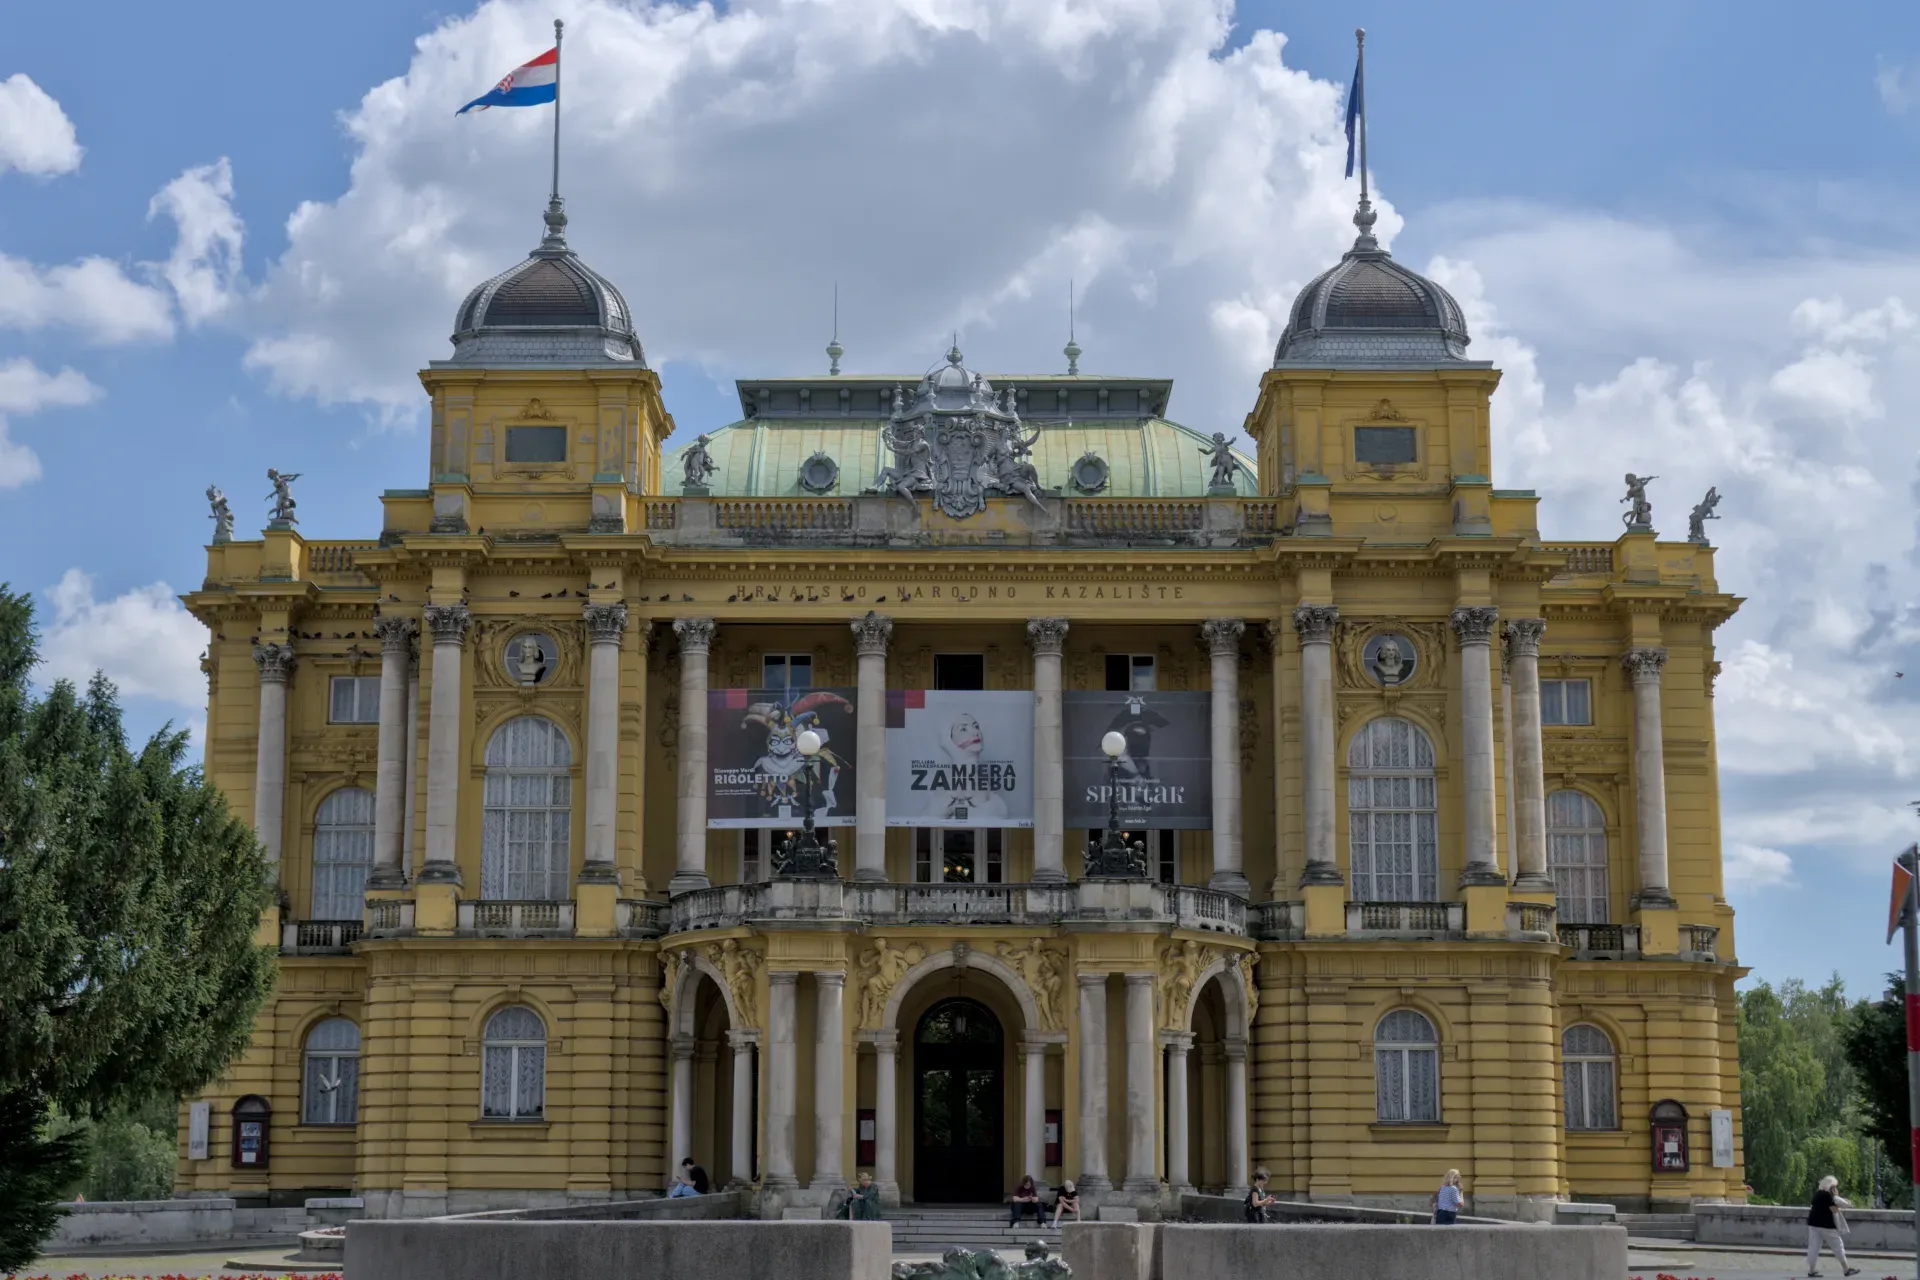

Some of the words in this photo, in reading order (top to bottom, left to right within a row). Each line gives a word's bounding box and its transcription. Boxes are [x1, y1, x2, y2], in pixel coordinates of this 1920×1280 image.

[736, 585, 866, 598] HRVATSKO
[897, 585, 1016, 598] NARODNO
[1046, 584, 1183, 599] KAZALIŠTE
[951, 764, 1016, 777] MJERA
[714, 773, 789, 784] RIGOLETTO
